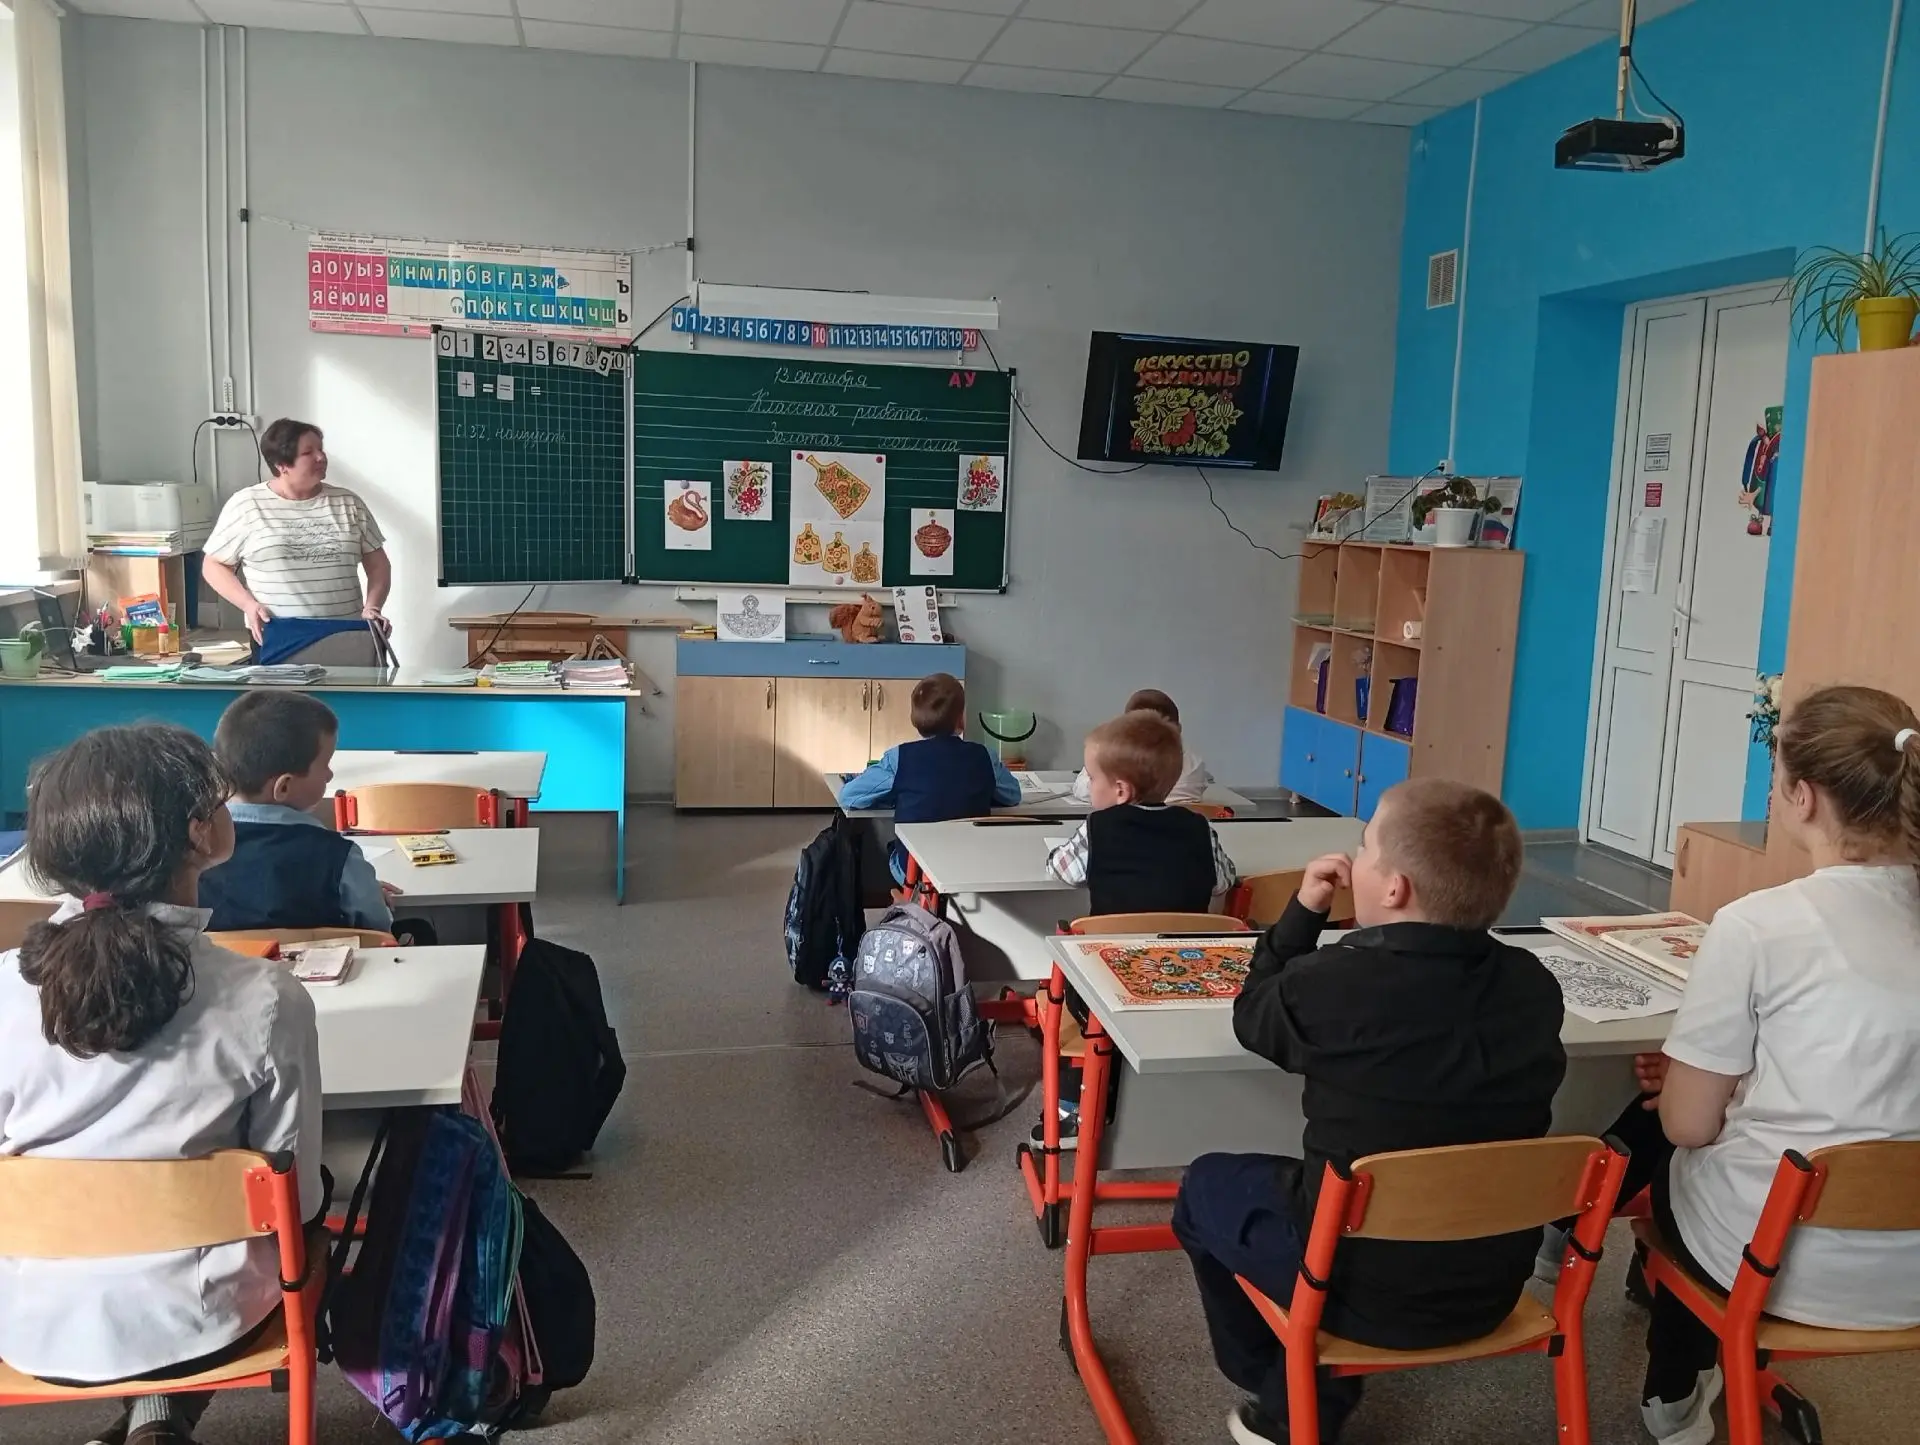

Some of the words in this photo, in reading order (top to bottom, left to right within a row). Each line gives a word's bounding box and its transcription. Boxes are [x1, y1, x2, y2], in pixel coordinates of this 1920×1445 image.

[675, 312, 683, 328] 0
[690, 313, 696, 330] 1
[703, 316, 712, 332] 2
[717, 317, 726, 334] 3
[731, 320, 740, 336] 4
[745, 321, 753, 338] 5
[759, 322, 768, 338] 6
[774, 323, 782, 339] 7
[787, 324, 796, 341] 8
[801, 325, 809, 342] 9
[814, 327, 826, 344] 10
[828, 328, 840, 345] 11
[843, 328, 856, 345] 12
[859, 329, 872, 345] 13
[874, 329, 888, 346] 14
[890, 329, 902, 346] 15
[905, 330, 918, 346] 16
[920, 330, 933, 346] 17
[934, 330, 948, 347] 18
[949, 330, 962, 347] 19
[963, 331, 977, 348] 20
[440, 335, 451, 351] 0
[461, 338, 468, 353] 1
[486, 340, 495, 356] 2
[515, 343, 526, 359] 4
[535, 345, 546, 361] 5
[556, 346, 566, 361] 6
[572, 346, 580, 362] 7
[598, 356, 609, 371] 9
[1133, 350, 1250, 373] ИСКУССТВО
[774, 367, 789, 384] 13
[1136, 368, 1243, 388] ХОХЛОМЫ
[747, 387, 839, 417] Классная
[851, 401, 928, 427] работа.
[766, 421, 843, 447] Золотая
